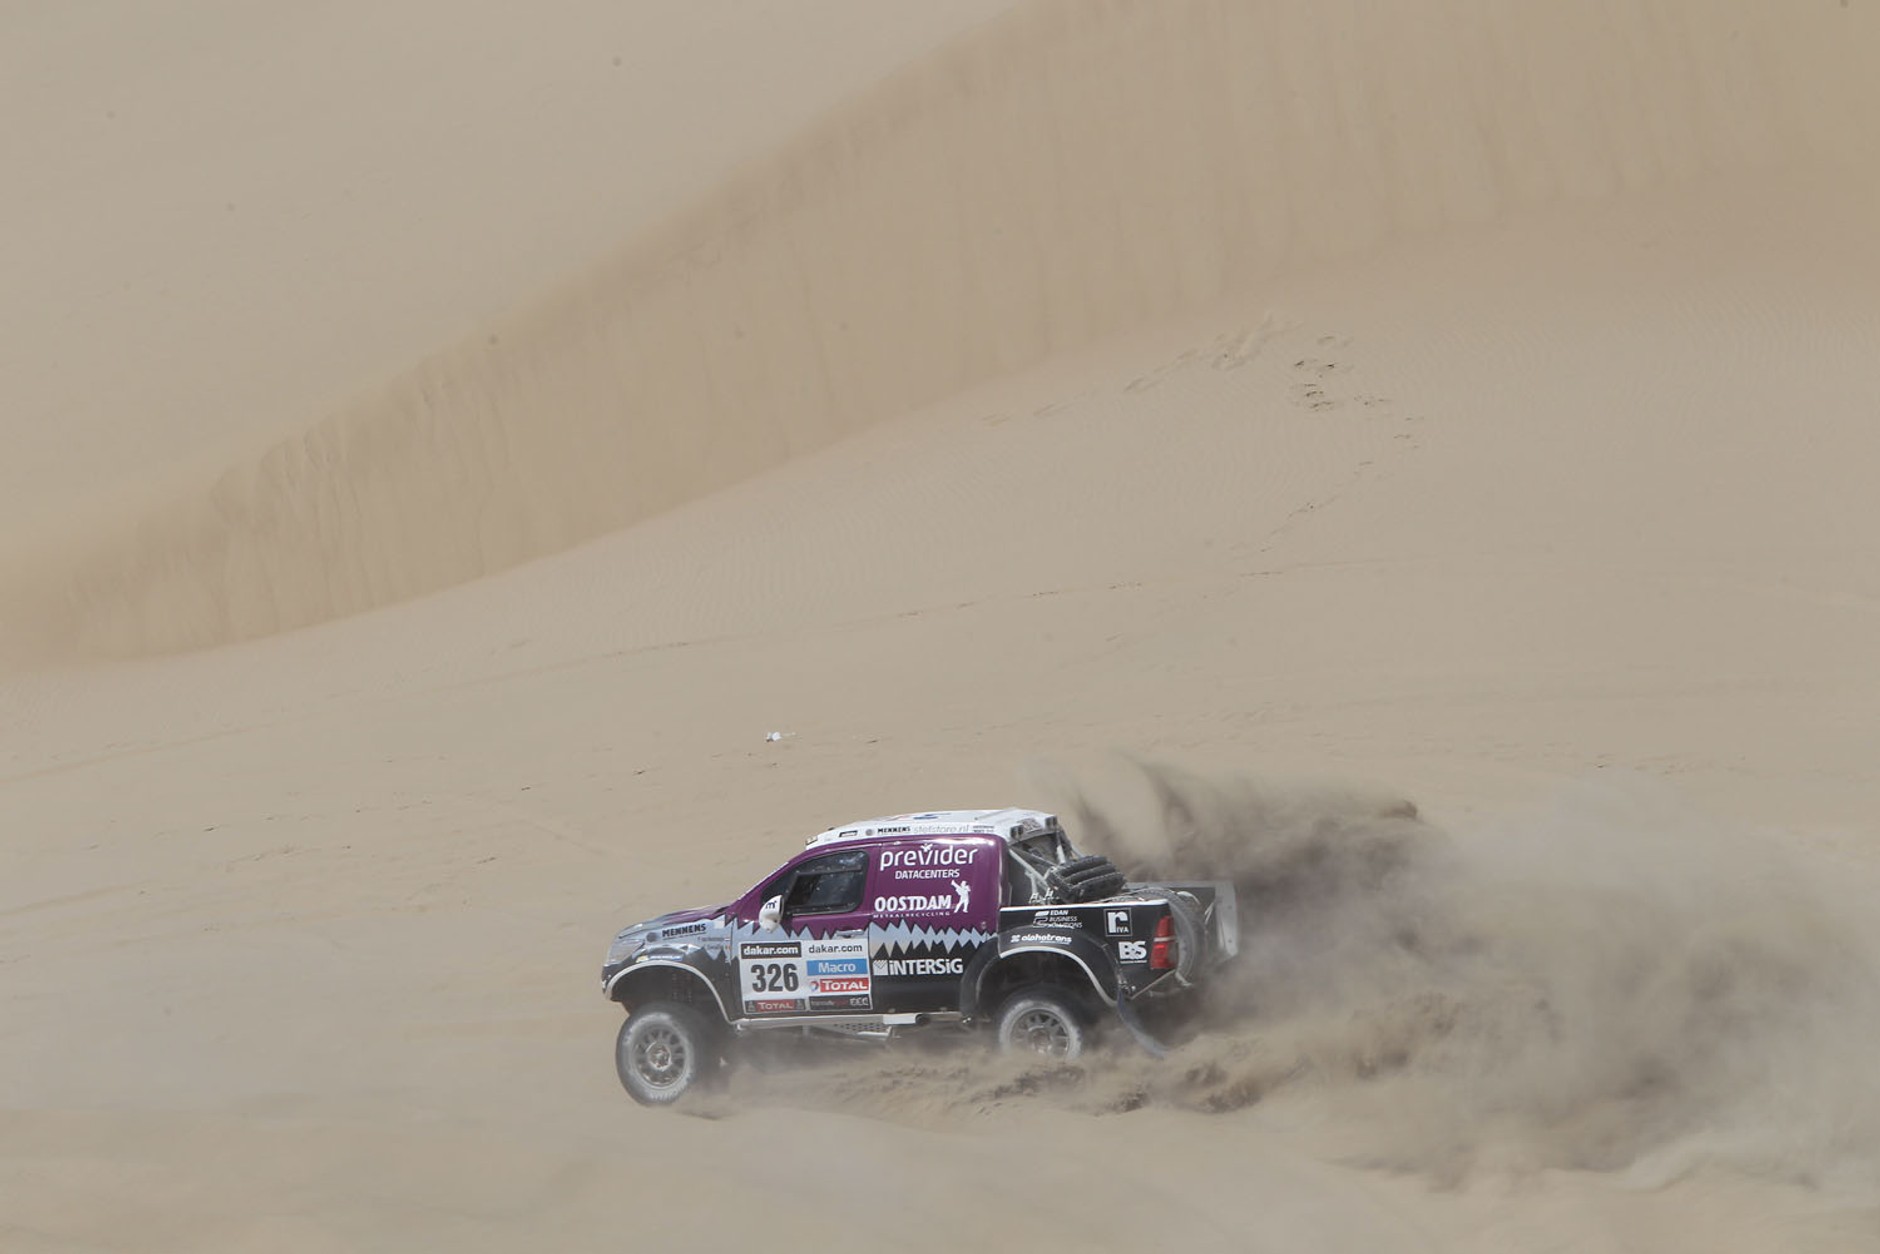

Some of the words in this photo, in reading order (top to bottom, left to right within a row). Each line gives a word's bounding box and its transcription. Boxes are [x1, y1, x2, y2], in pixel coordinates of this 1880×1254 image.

[880, 845, 978, 871] previder
[895, 869, 960, 880] DATACENTERS
[874, 895, 952, 912] OOSTDAM
[662, 923, 707, 938] MENNENS
[743, 945, 799, 956] dakar.com
[808, 944, 863, 954] dakar.com
[818, 962, 857, 973] Macro
[750, 963, 800, 993] 326
[822, 980, 868, 991] TOTAL
[757, 1002, 793, 1011] TOTAL
